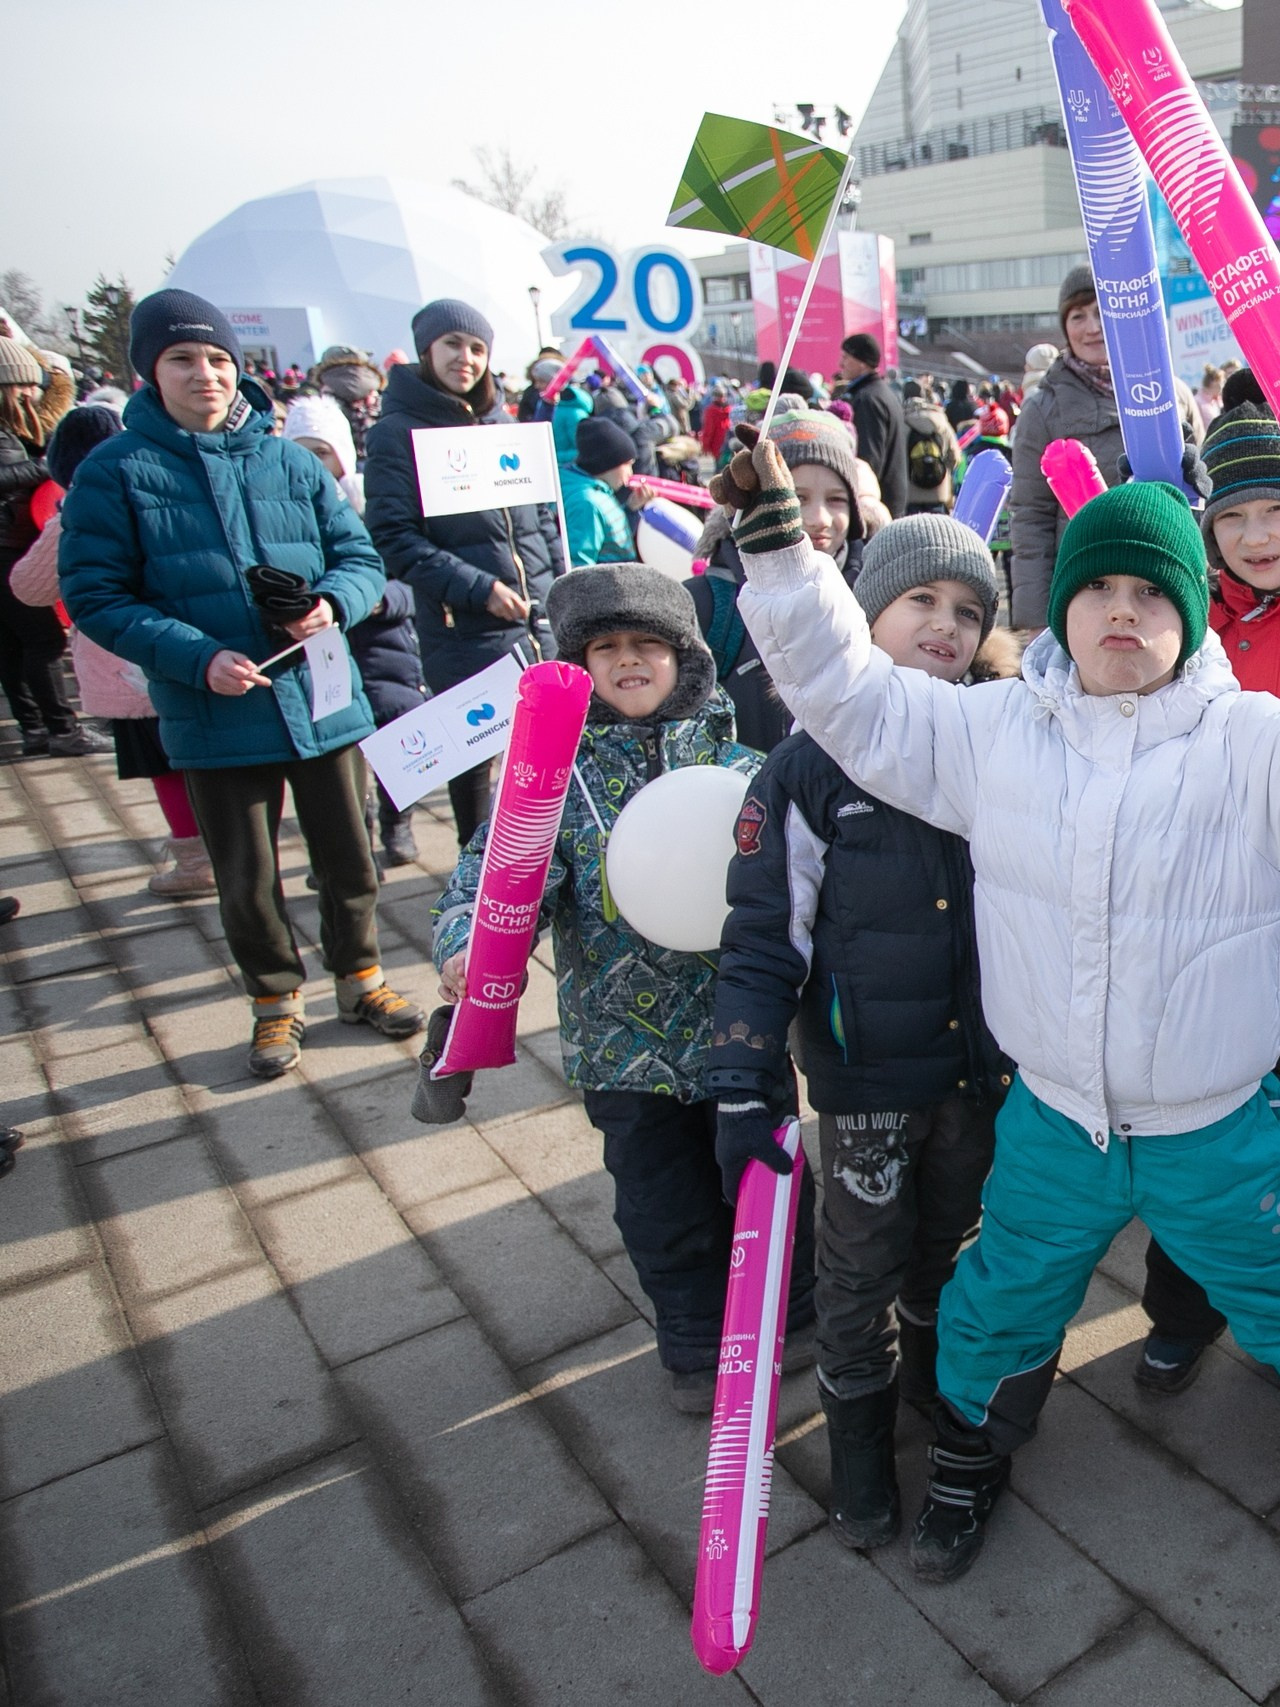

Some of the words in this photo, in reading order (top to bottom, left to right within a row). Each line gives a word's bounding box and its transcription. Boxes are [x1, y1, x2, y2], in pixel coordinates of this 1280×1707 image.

[562, 247, 694, 333] 20
[1223, 270, 1268, 306] ОГНЯ
[1108, 291, 1149, 309] ОГНЯ
[177, 322, 214, 332] Columbia
[1123, 400, 1174, 417] NORNICKEL
[494, 477, 532, 487] NORNICKEL
[489, 912, 531, 926] ОГНЯ
[835, 1114, 866, 1130] WILD
[871, 1112, 909, 1130] WOLF
